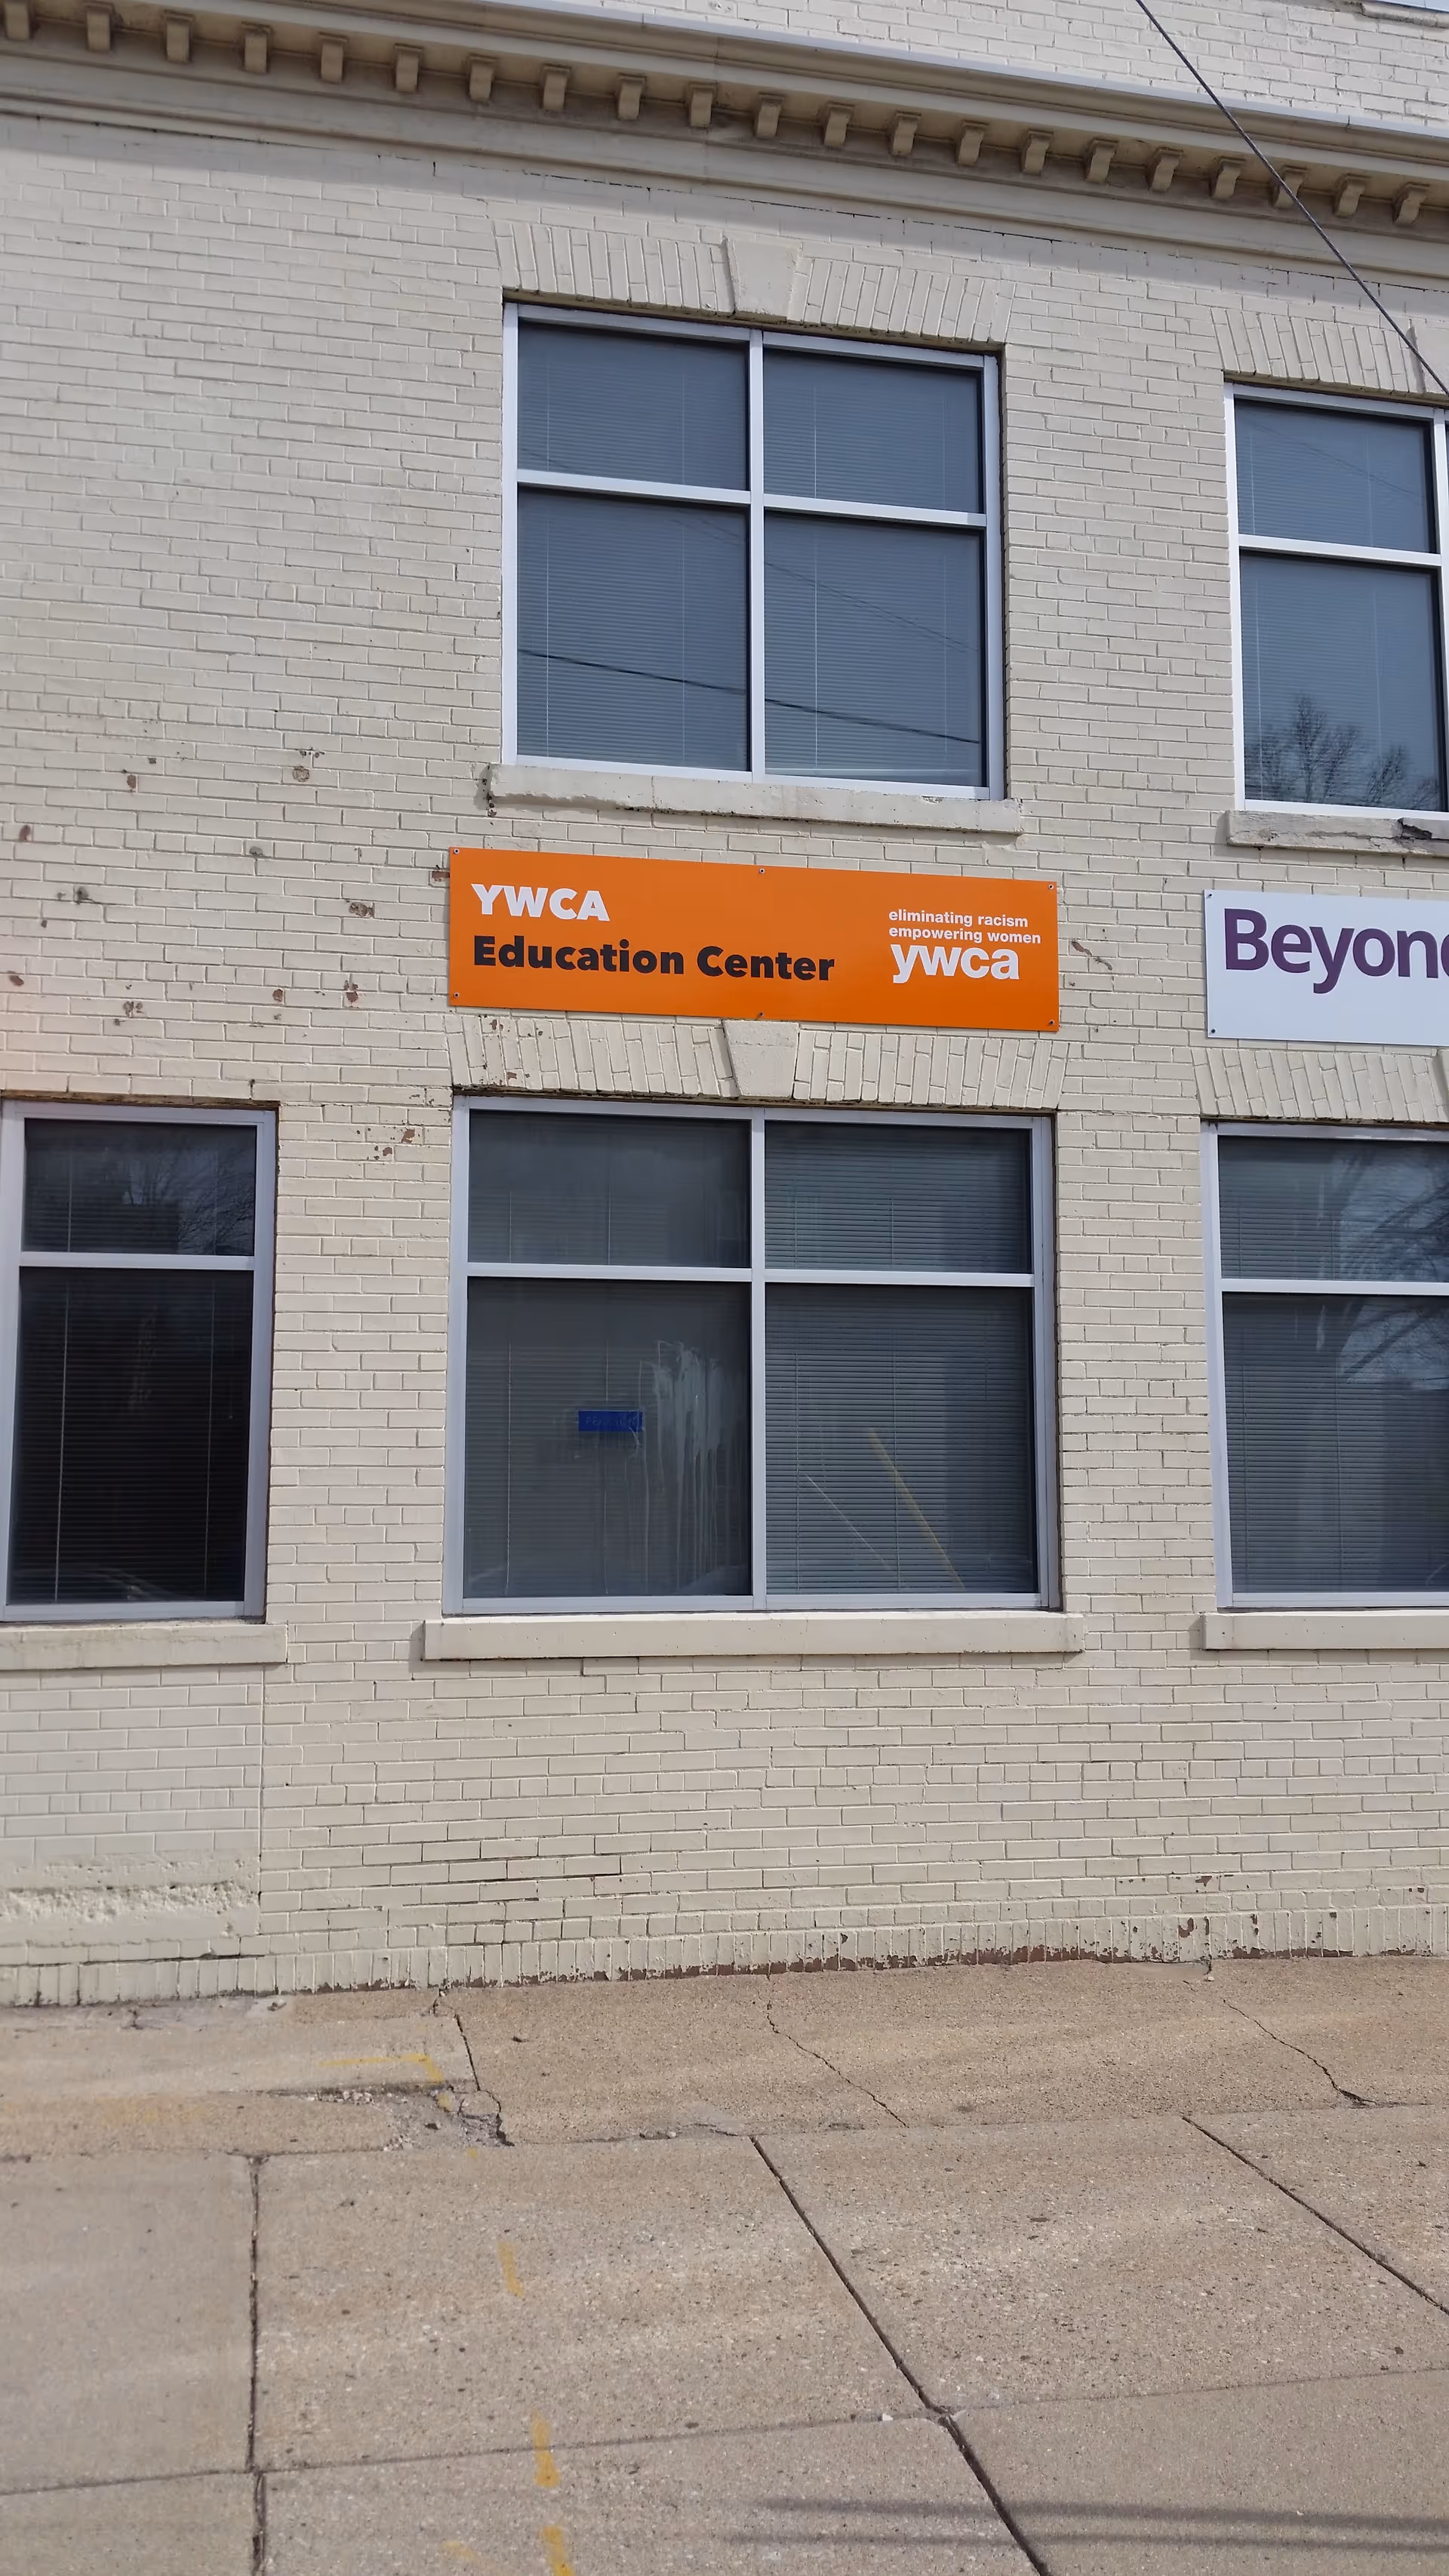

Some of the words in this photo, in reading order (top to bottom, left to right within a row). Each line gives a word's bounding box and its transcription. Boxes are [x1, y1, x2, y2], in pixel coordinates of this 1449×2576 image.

[471, 883, 611, 922] YWCA
[888, 908, 973, 928] eliminating
[977, 914, 1029, 928] racism
[888, 926, 983, 943] empowering
[987, 932, 1041, 944] women
[1223, 907, 1449, 994] Beyon
[474, 935, 685, 975] Education
[697, 946, 835, 982] Center
[890, 943, 1020, 984] ywca
